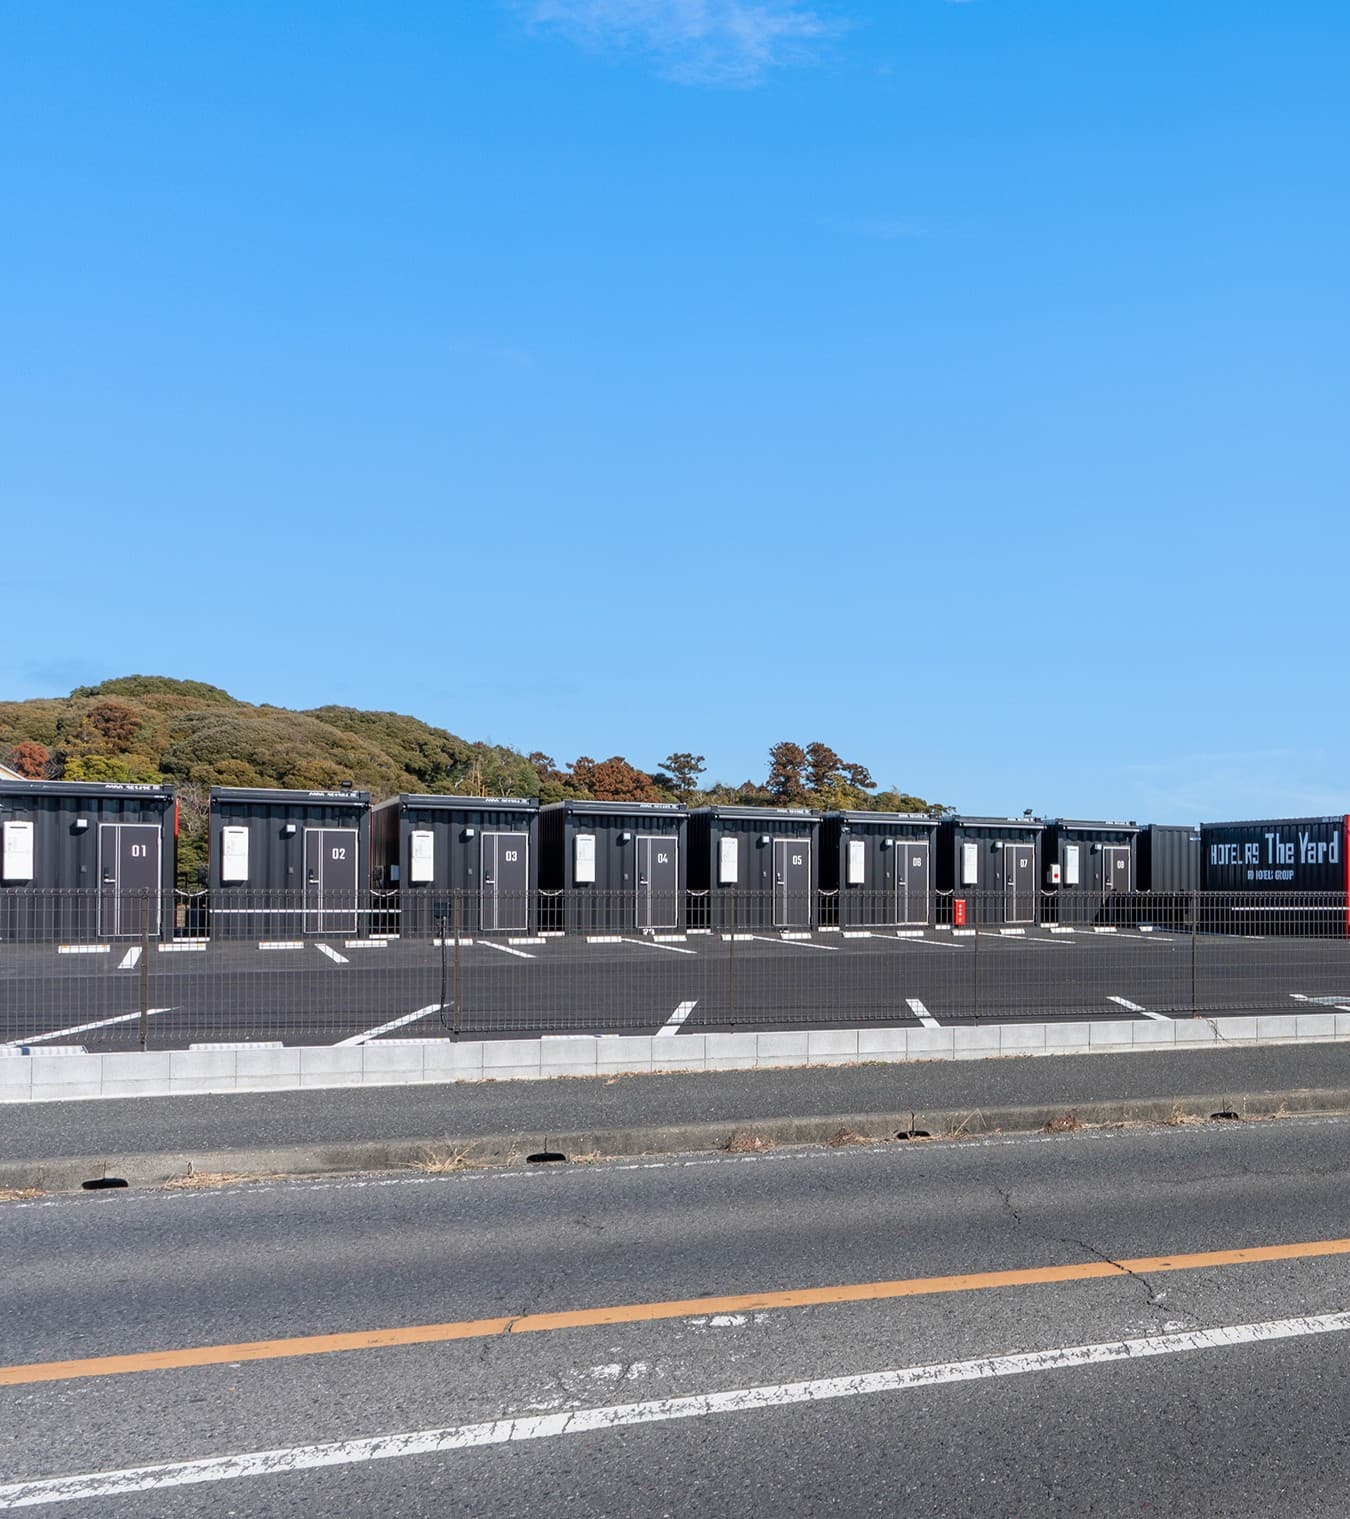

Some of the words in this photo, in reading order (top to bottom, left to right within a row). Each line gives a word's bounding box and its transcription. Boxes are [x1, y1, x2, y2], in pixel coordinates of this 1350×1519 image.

[131, 844, 147, 857] 01
[1210, 843, 1243, 865] HOTEL
[1245, 843, 1259, 865] R9
[1264, 832, 1295, 865] The
[1298, 830, 1339, 864] Yard
[332, 848, 346, 860] 02
[505, 850, 518, 862] 03
[657, 853, 669, 864] 04
[792, 855, 803, 865] 05
[1019, 858, 1028, 868] 07
